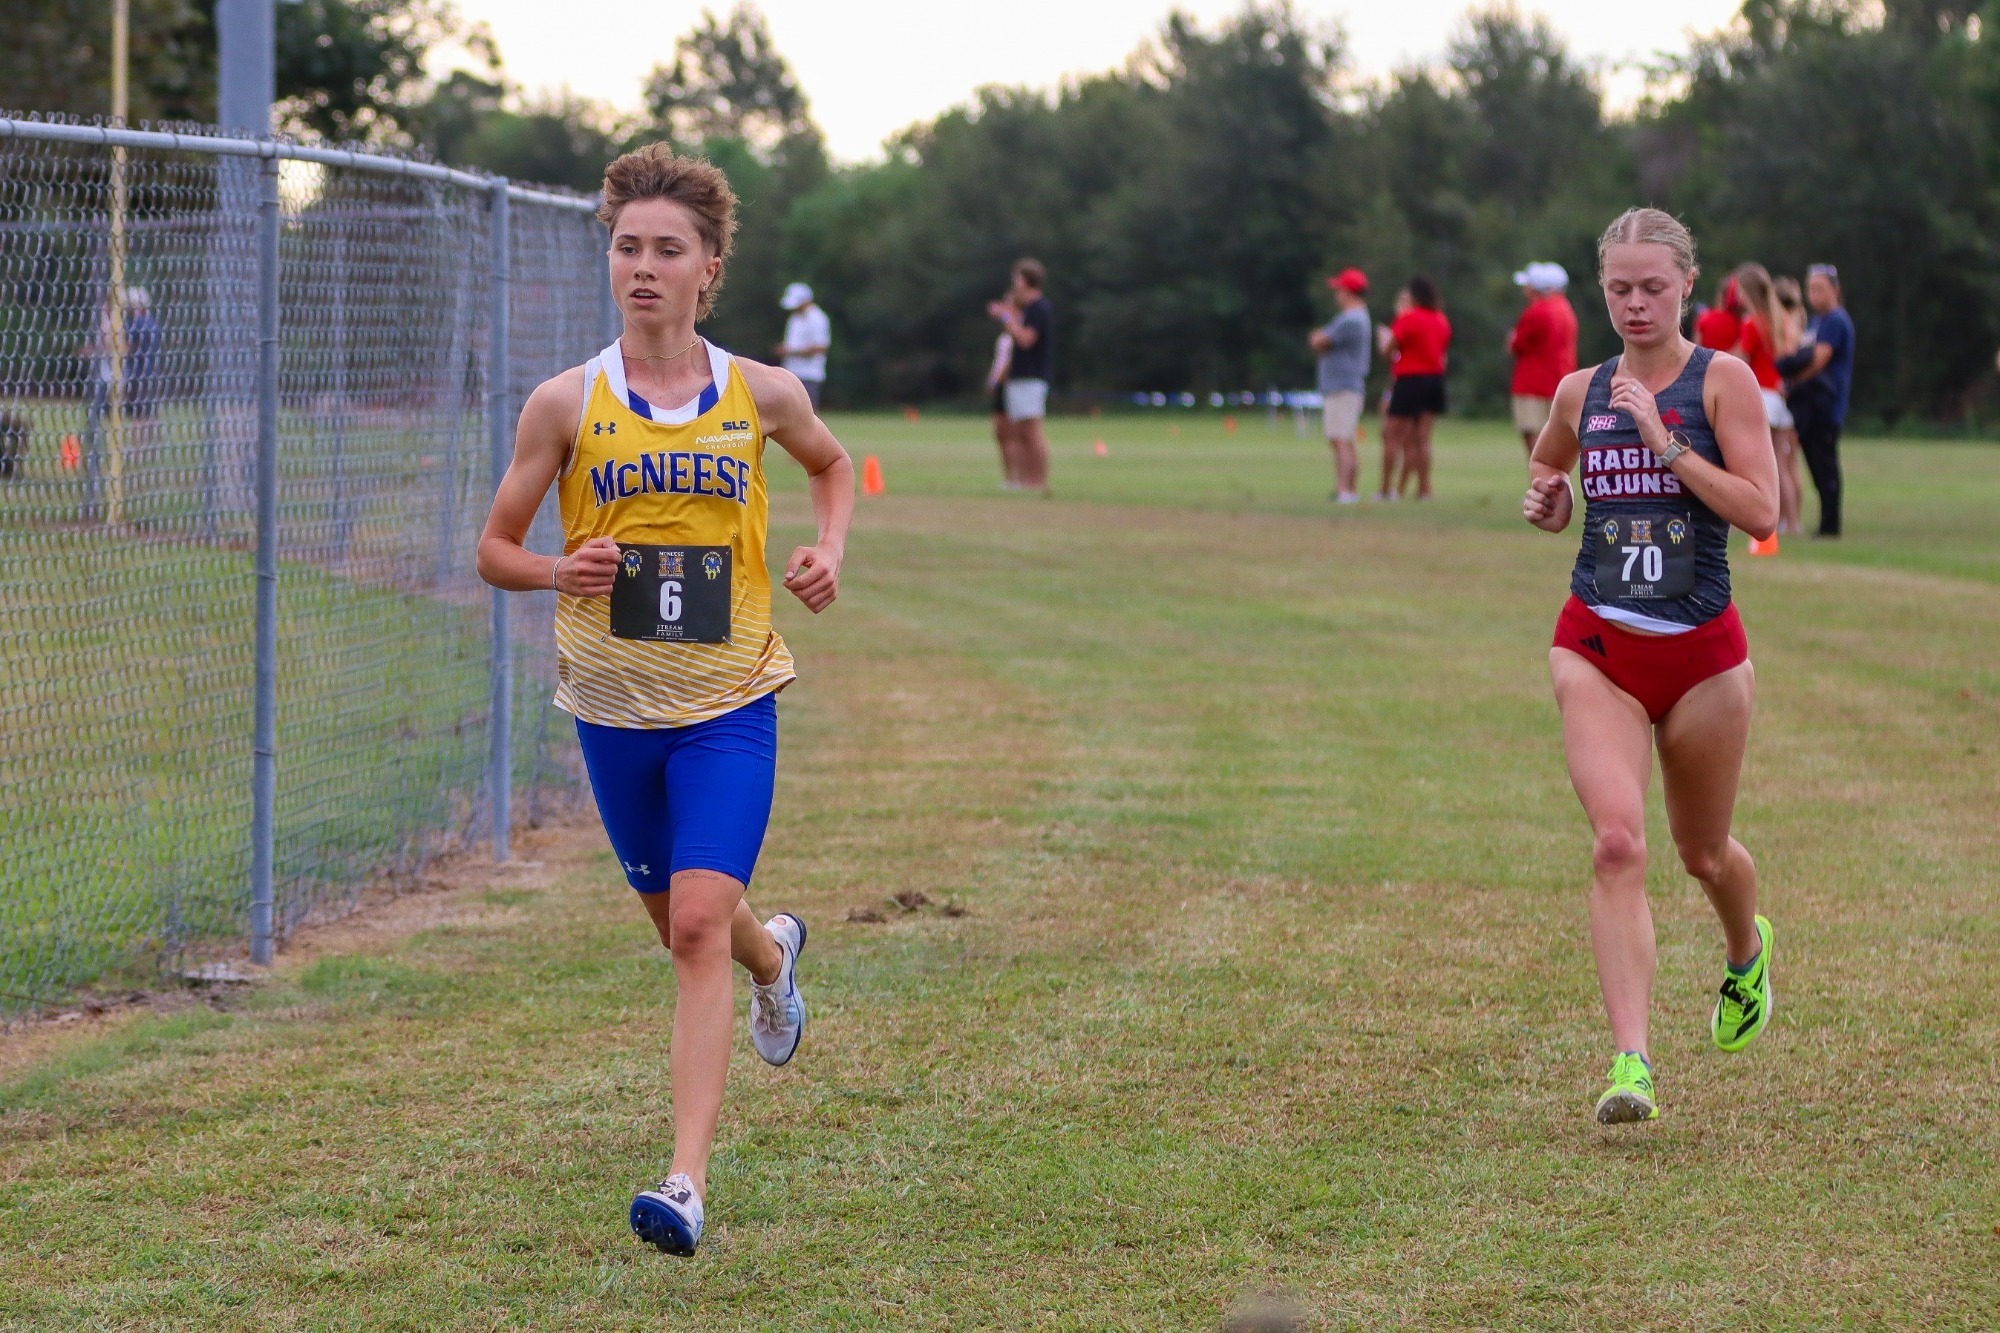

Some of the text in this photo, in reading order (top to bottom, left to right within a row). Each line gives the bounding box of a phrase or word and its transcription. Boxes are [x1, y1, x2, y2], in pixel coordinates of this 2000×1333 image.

[695, 432, 753, 445] NAVARRE
[705, 441, 748, 450] CHEVROLET
[1583, 472, 1681, 498] CAJUNS
[1621, 546, 1663, 582] 70
[659, 580, 683, 622] 6
